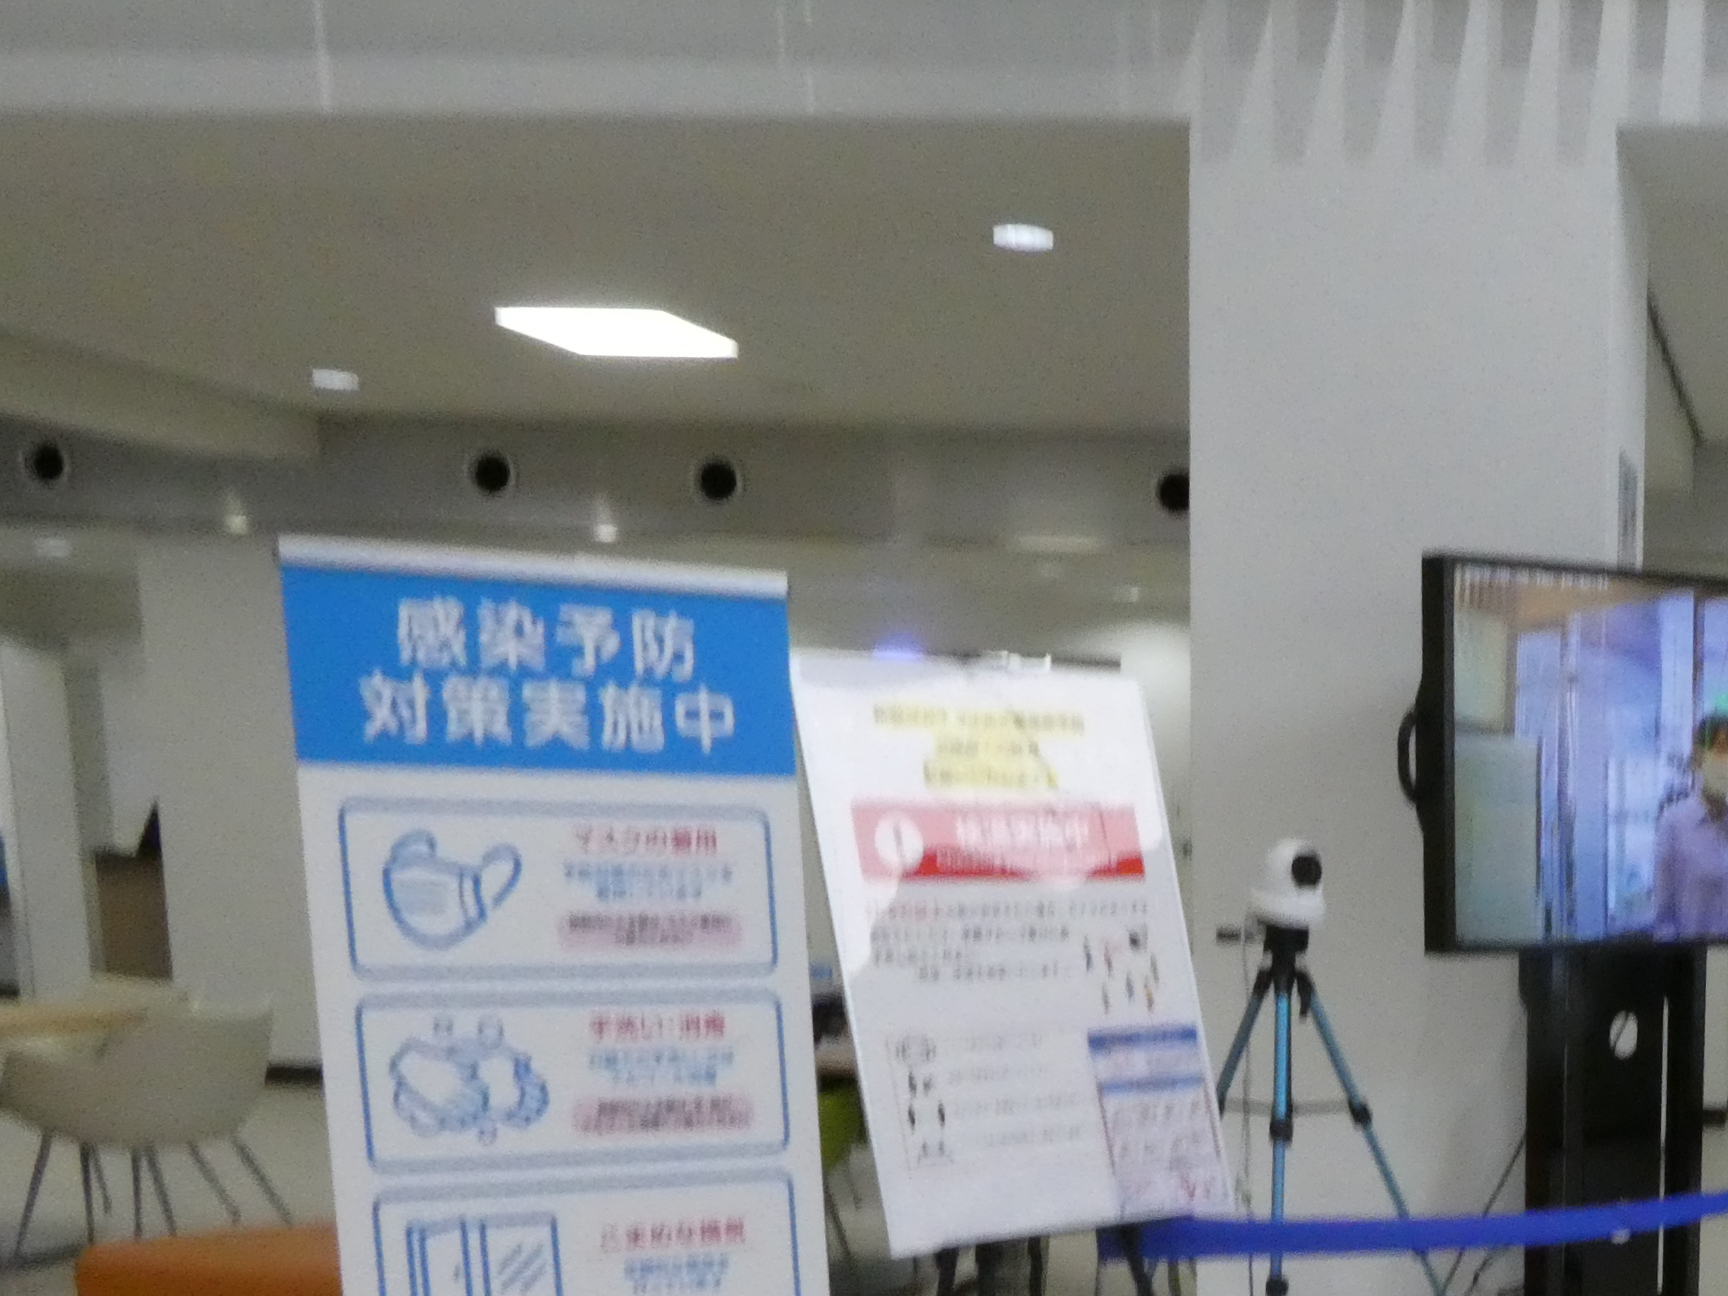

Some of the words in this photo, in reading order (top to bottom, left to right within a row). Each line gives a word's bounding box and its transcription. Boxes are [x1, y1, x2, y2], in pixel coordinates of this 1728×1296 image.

[397, 594, 694, 682] 感染予防
[360, 669, 735, 753] 対策実施中
